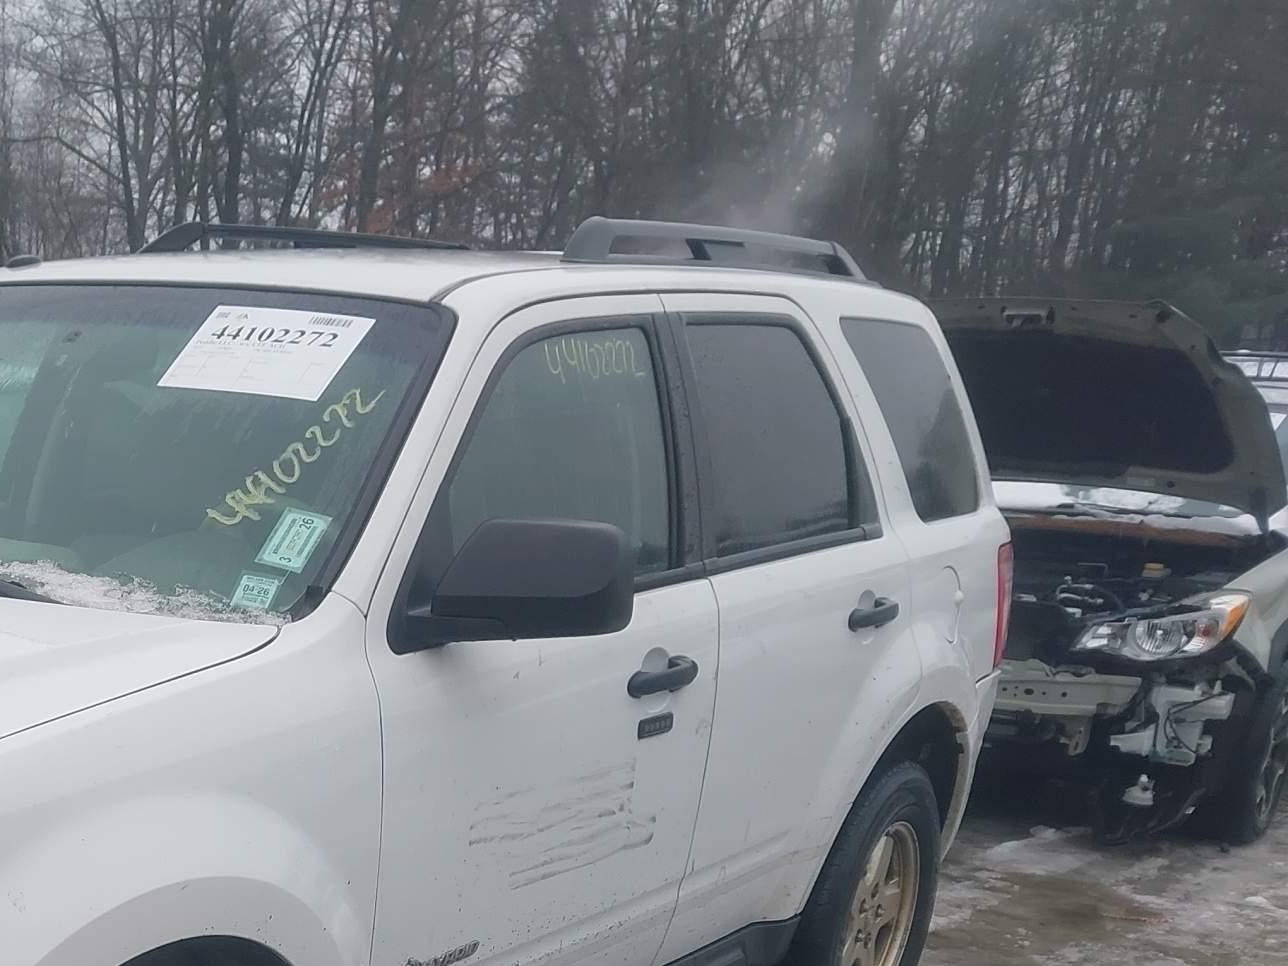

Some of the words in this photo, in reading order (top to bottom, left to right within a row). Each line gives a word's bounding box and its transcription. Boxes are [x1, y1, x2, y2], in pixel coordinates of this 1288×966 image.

[211, 324, 340, 348] 44102272
[206, 387, 386, 525] 44102272
[298, 517, 314, 530] 26
